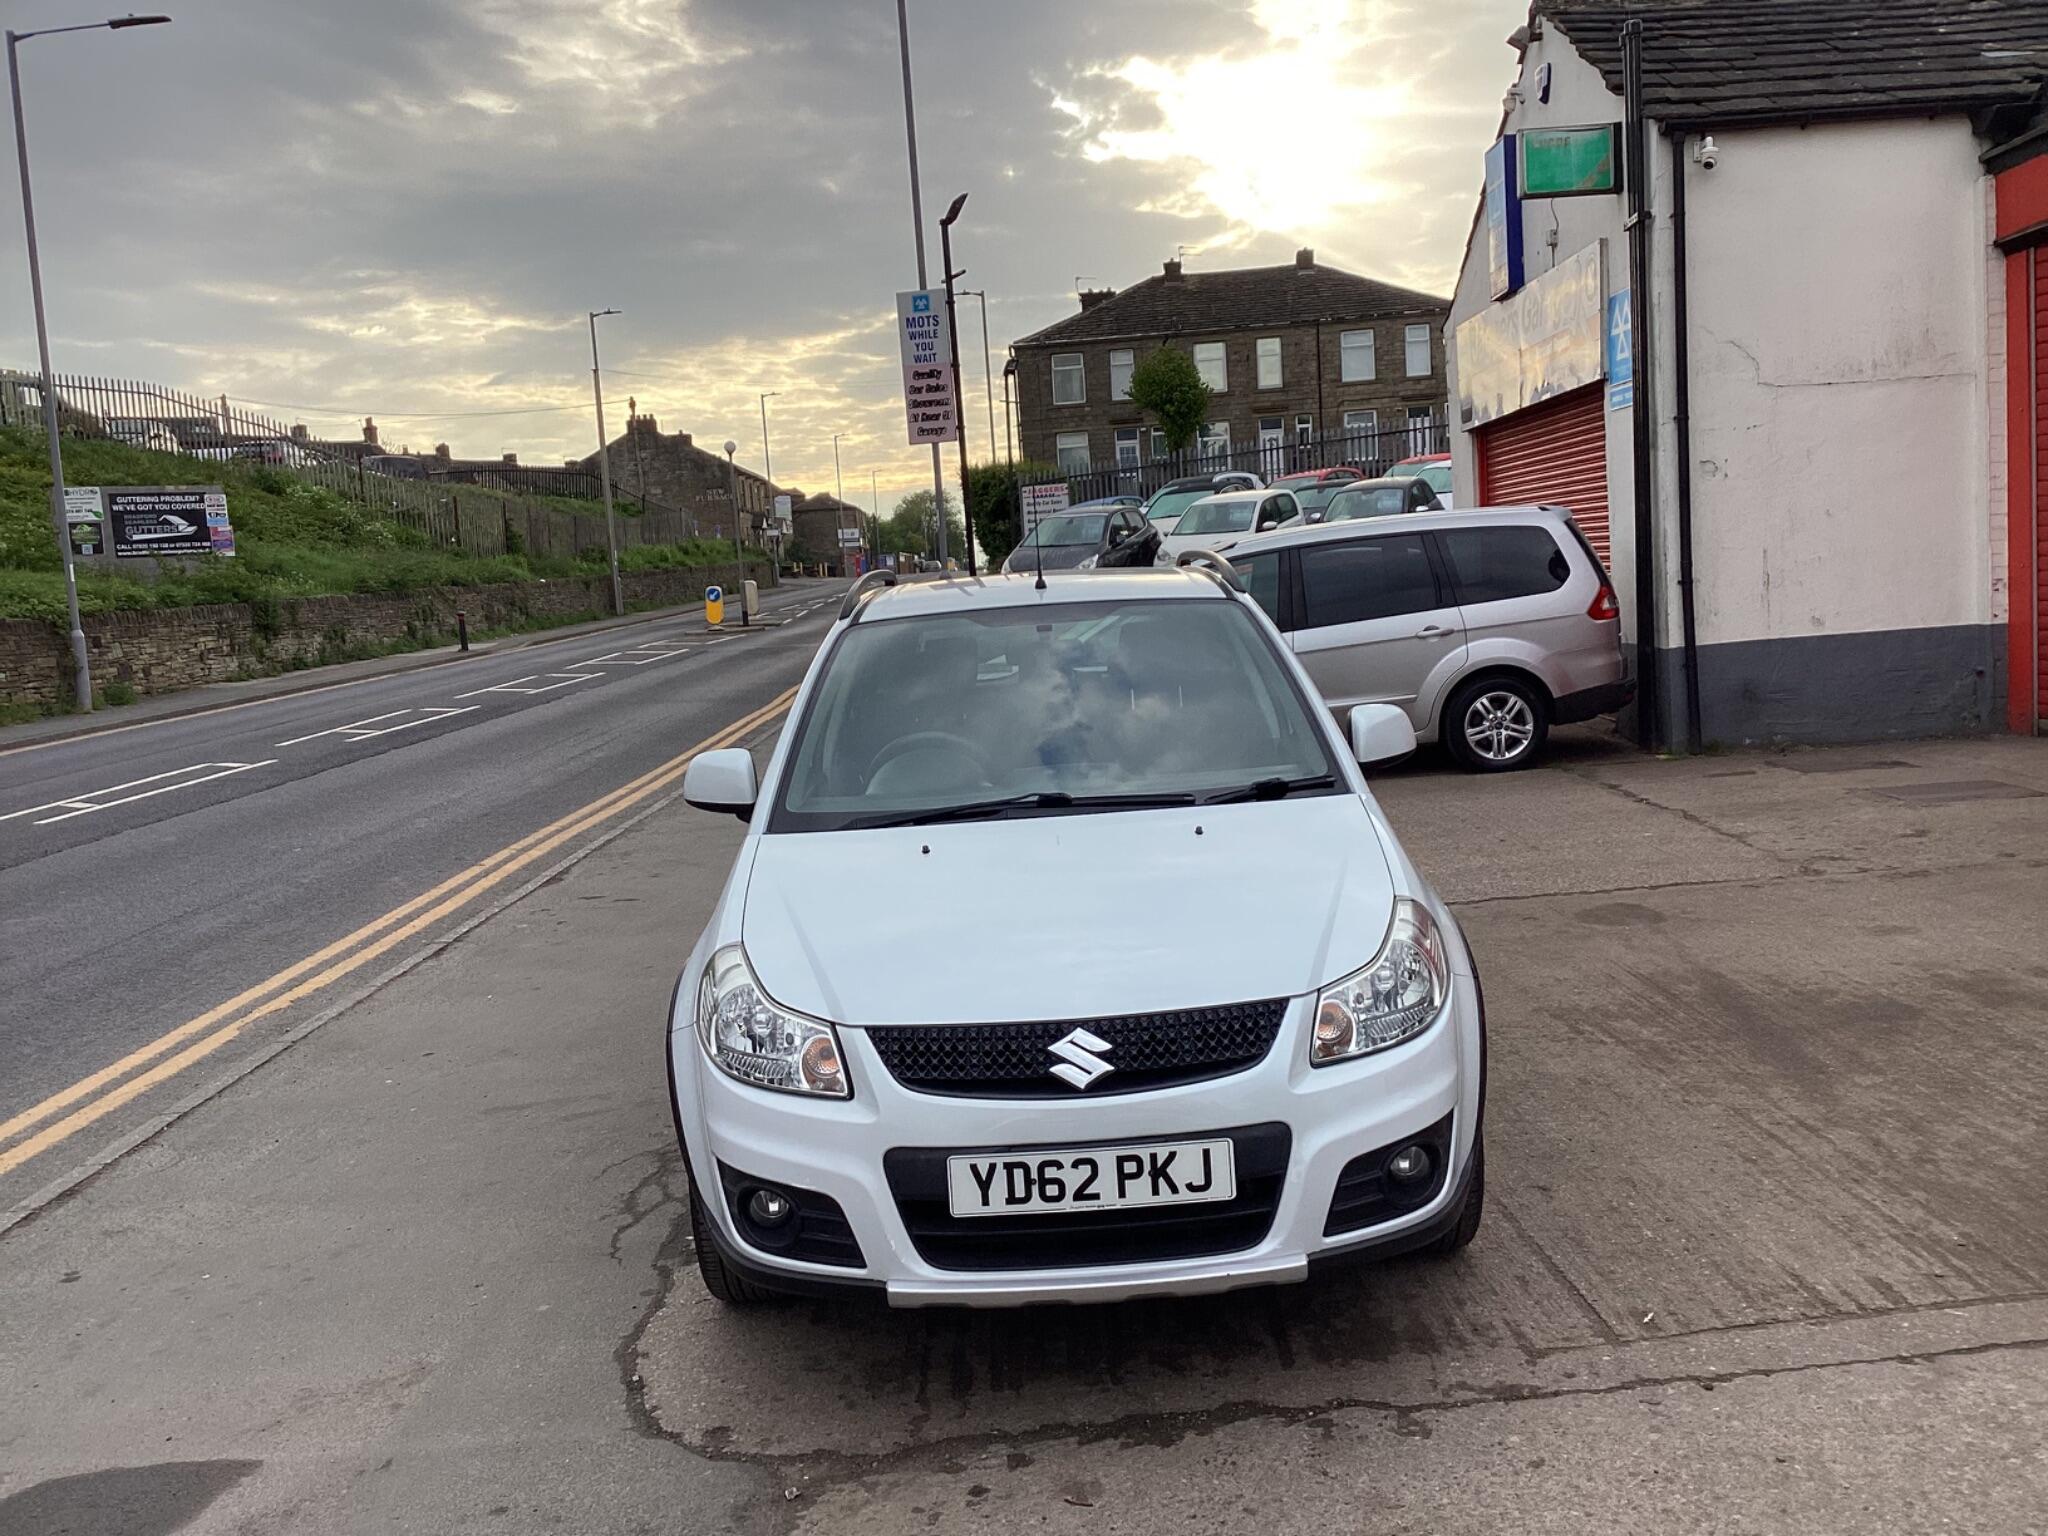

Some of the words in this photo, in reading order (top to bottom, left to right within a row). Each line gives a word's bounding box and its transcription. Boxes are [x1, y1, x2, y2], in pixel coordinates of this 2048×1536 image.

[906, 315, 940, 329] MOTS
[908, 329, 939, 341] WHILE
[914, 341, 934, 352] YOU
[913, 353, 937, 364] WAIT
[116, 495, 159, 504] GUTTERING
[112, 503, 136, 512] WE'VE
[137, 503, 153, 511] GOT
[153, 502, 170, 511] YOU
[171, 502, 205, 510] COVERED
[125, 525, 178, 535] GUTTERS
[969, 1157, 1101, 1206] YD62
[1115, 1147, 1213, 1199] PKJ
